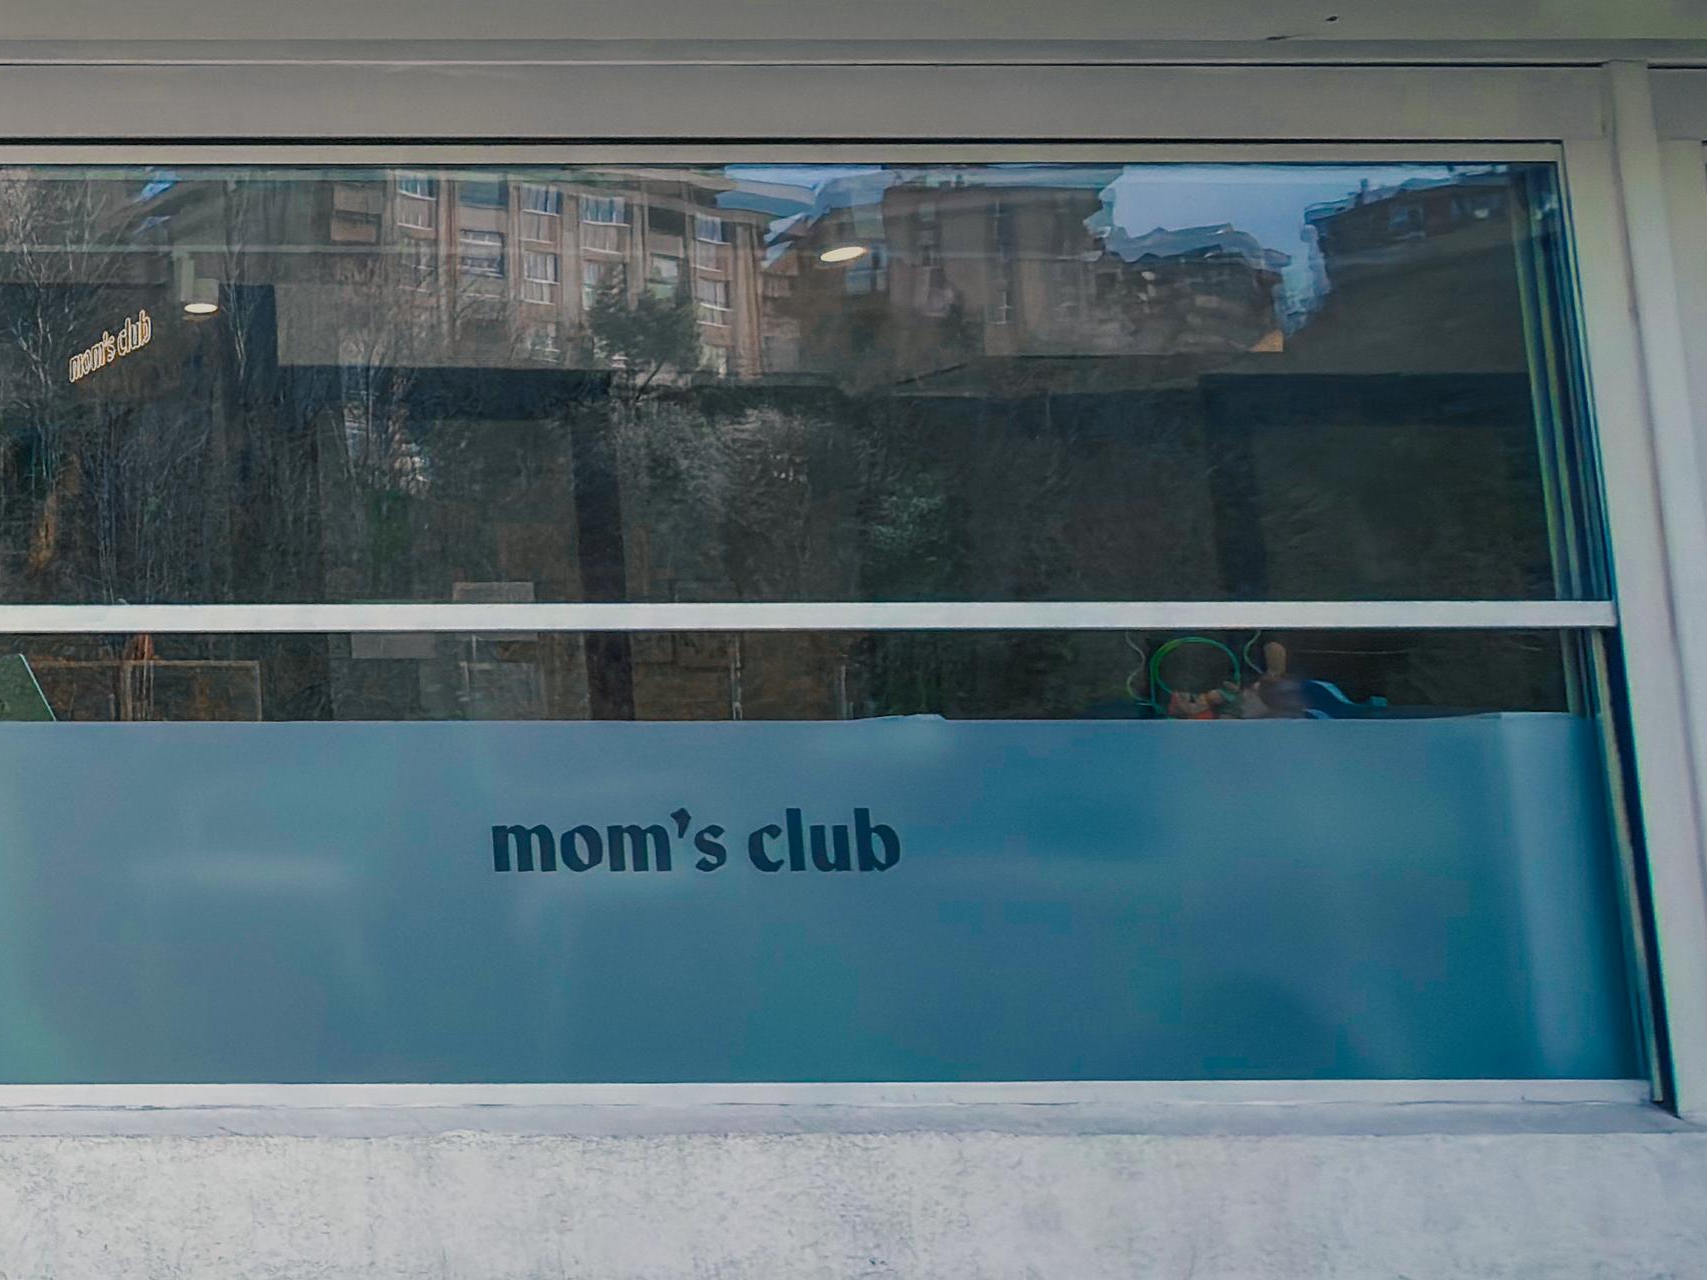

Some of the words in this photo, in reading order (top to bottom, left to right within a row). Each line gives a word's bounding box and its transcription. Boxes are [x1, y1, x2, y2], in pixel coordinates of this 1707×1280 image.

[117, 309, 151, 356] club
[491, 808, 727, 872] mom's
[748, 807, 901, 872] club
